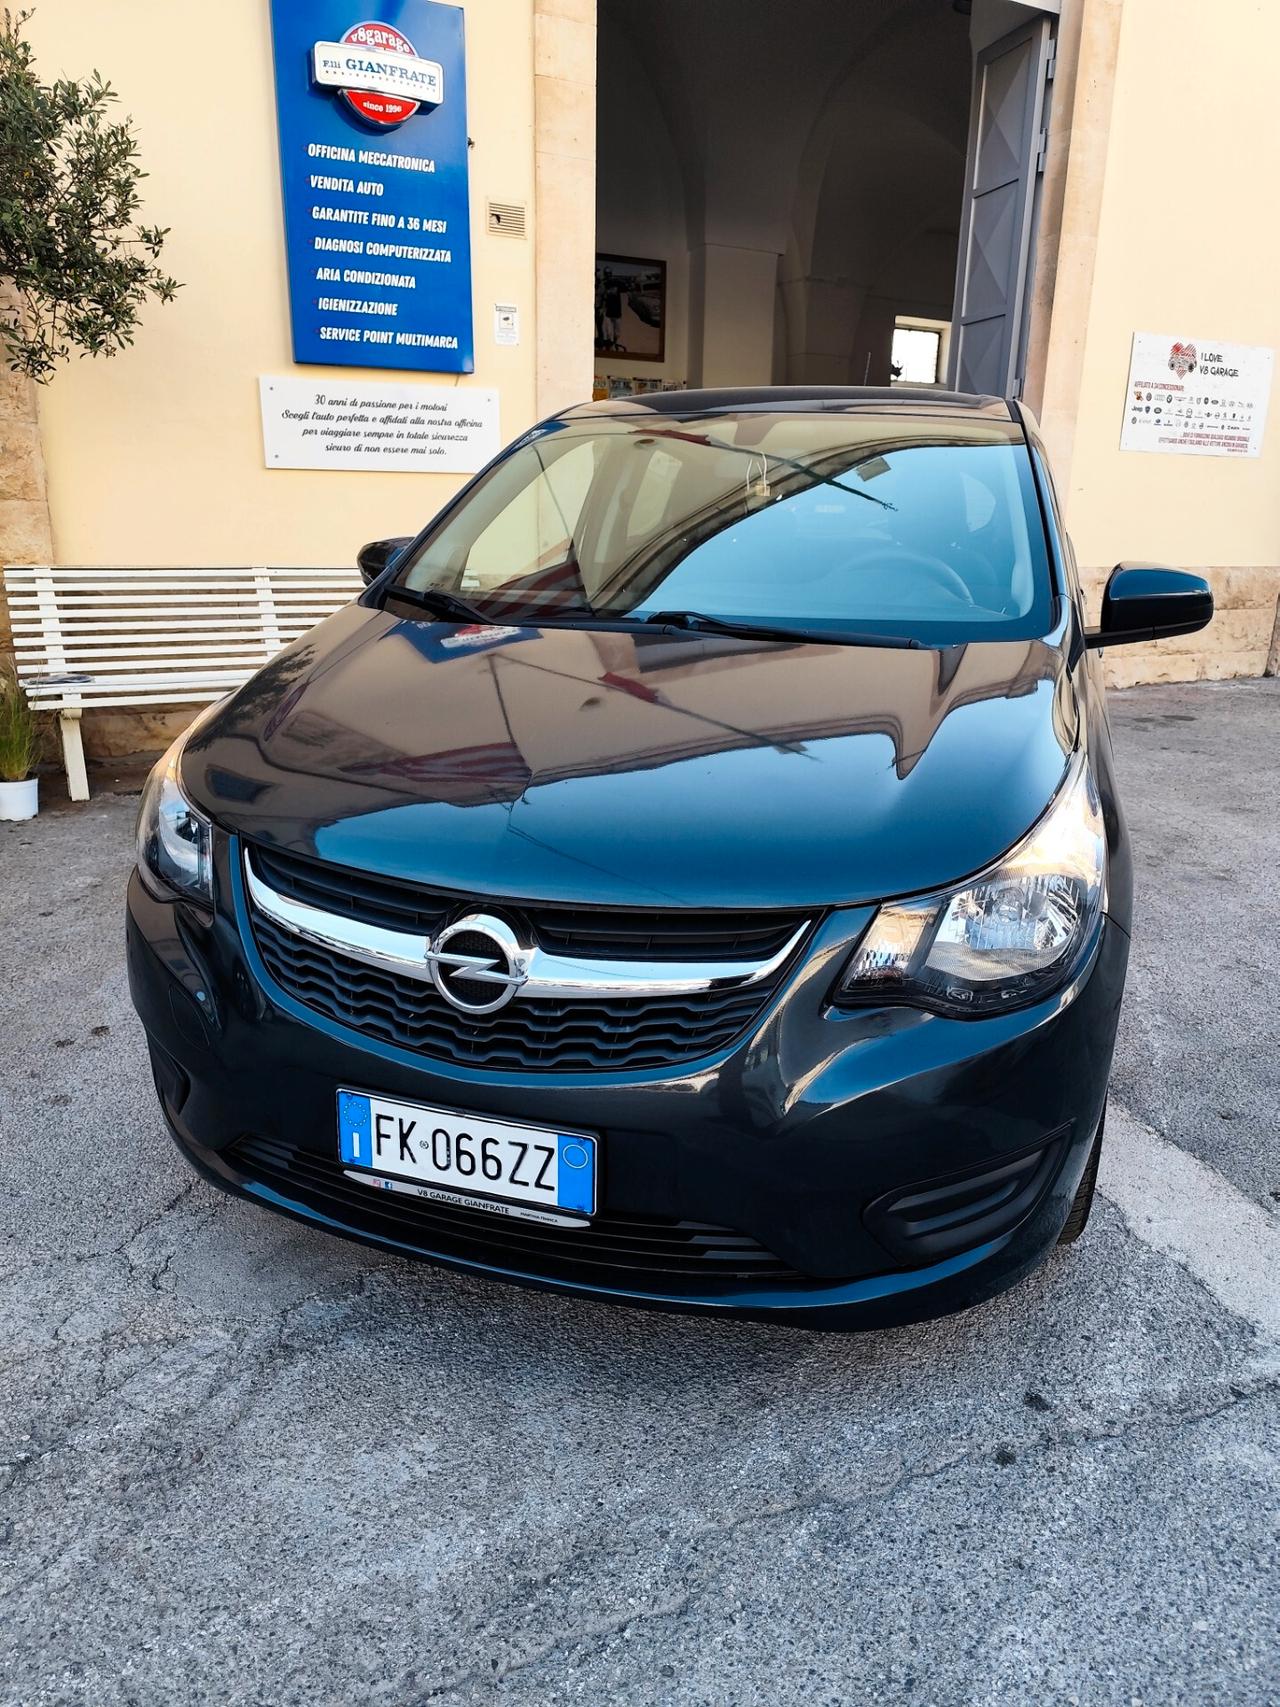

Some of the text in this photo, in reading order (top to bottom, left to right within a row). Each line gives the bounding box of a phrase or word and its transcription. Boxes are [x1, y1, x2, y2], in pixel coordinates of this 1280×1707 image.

[322, 58, 437, 87] F.lli GIANFRATE
[363, 101, 384, 112] since
[308, 143, 436, 173] OFFICINA MECCATRONICA
[310, 175, 385, 197] VENDITA AUTO
[312, 206, 447, 234] GARANTITE FINO A 36 MESI
[314, 237, 452, 263] DIAGNOSI COMPUTERIZZATA
[316, 267, 416, 289] ARIA CONDIZIONATA
[318, 297, 398, 316] IGIENIZZAZIONE
[320, 326, 458, 349] SERVICE POINT MULTIMARCA
[1204, 352, 1223, 363] LOVE
[1200, 365, 1239, 377] V8 GARAGE
[314, 394, 326, 405] 30
[328, 398, 348, 407] anni
[349, 398, 358, 407] di
[359, 399, 397, 410] passione
[398, 402, 414, 411] per
[420, 402, 449, 412] motori
[281, 409, 310, 421] Scegli
[311, 411, 335, 421] l'auto
[336, 412, 369, 424] perfetta
[379, 415, 408, 426] affidati
[409, 416, 426, 425] alla
[427, 417, 452, 427] nostra
[454, 418, 483, 428] officina
[302, 427, 468, 441] per viaggiare sempre in totale sicurezza
[325, 443, 351, 452] sicuro
[353, 443, 363, 452] di
[382, 446, 409, 454] essere
[410, 446, 427, 454] mai
[428, 446, 447, 455] solo.
[375, 1113, 417, 1164] FK
[431, 1128, 555, 1192] 066ZZ
[417, 1189, 510, 1214] V8 GARAGE GIANFRATE
